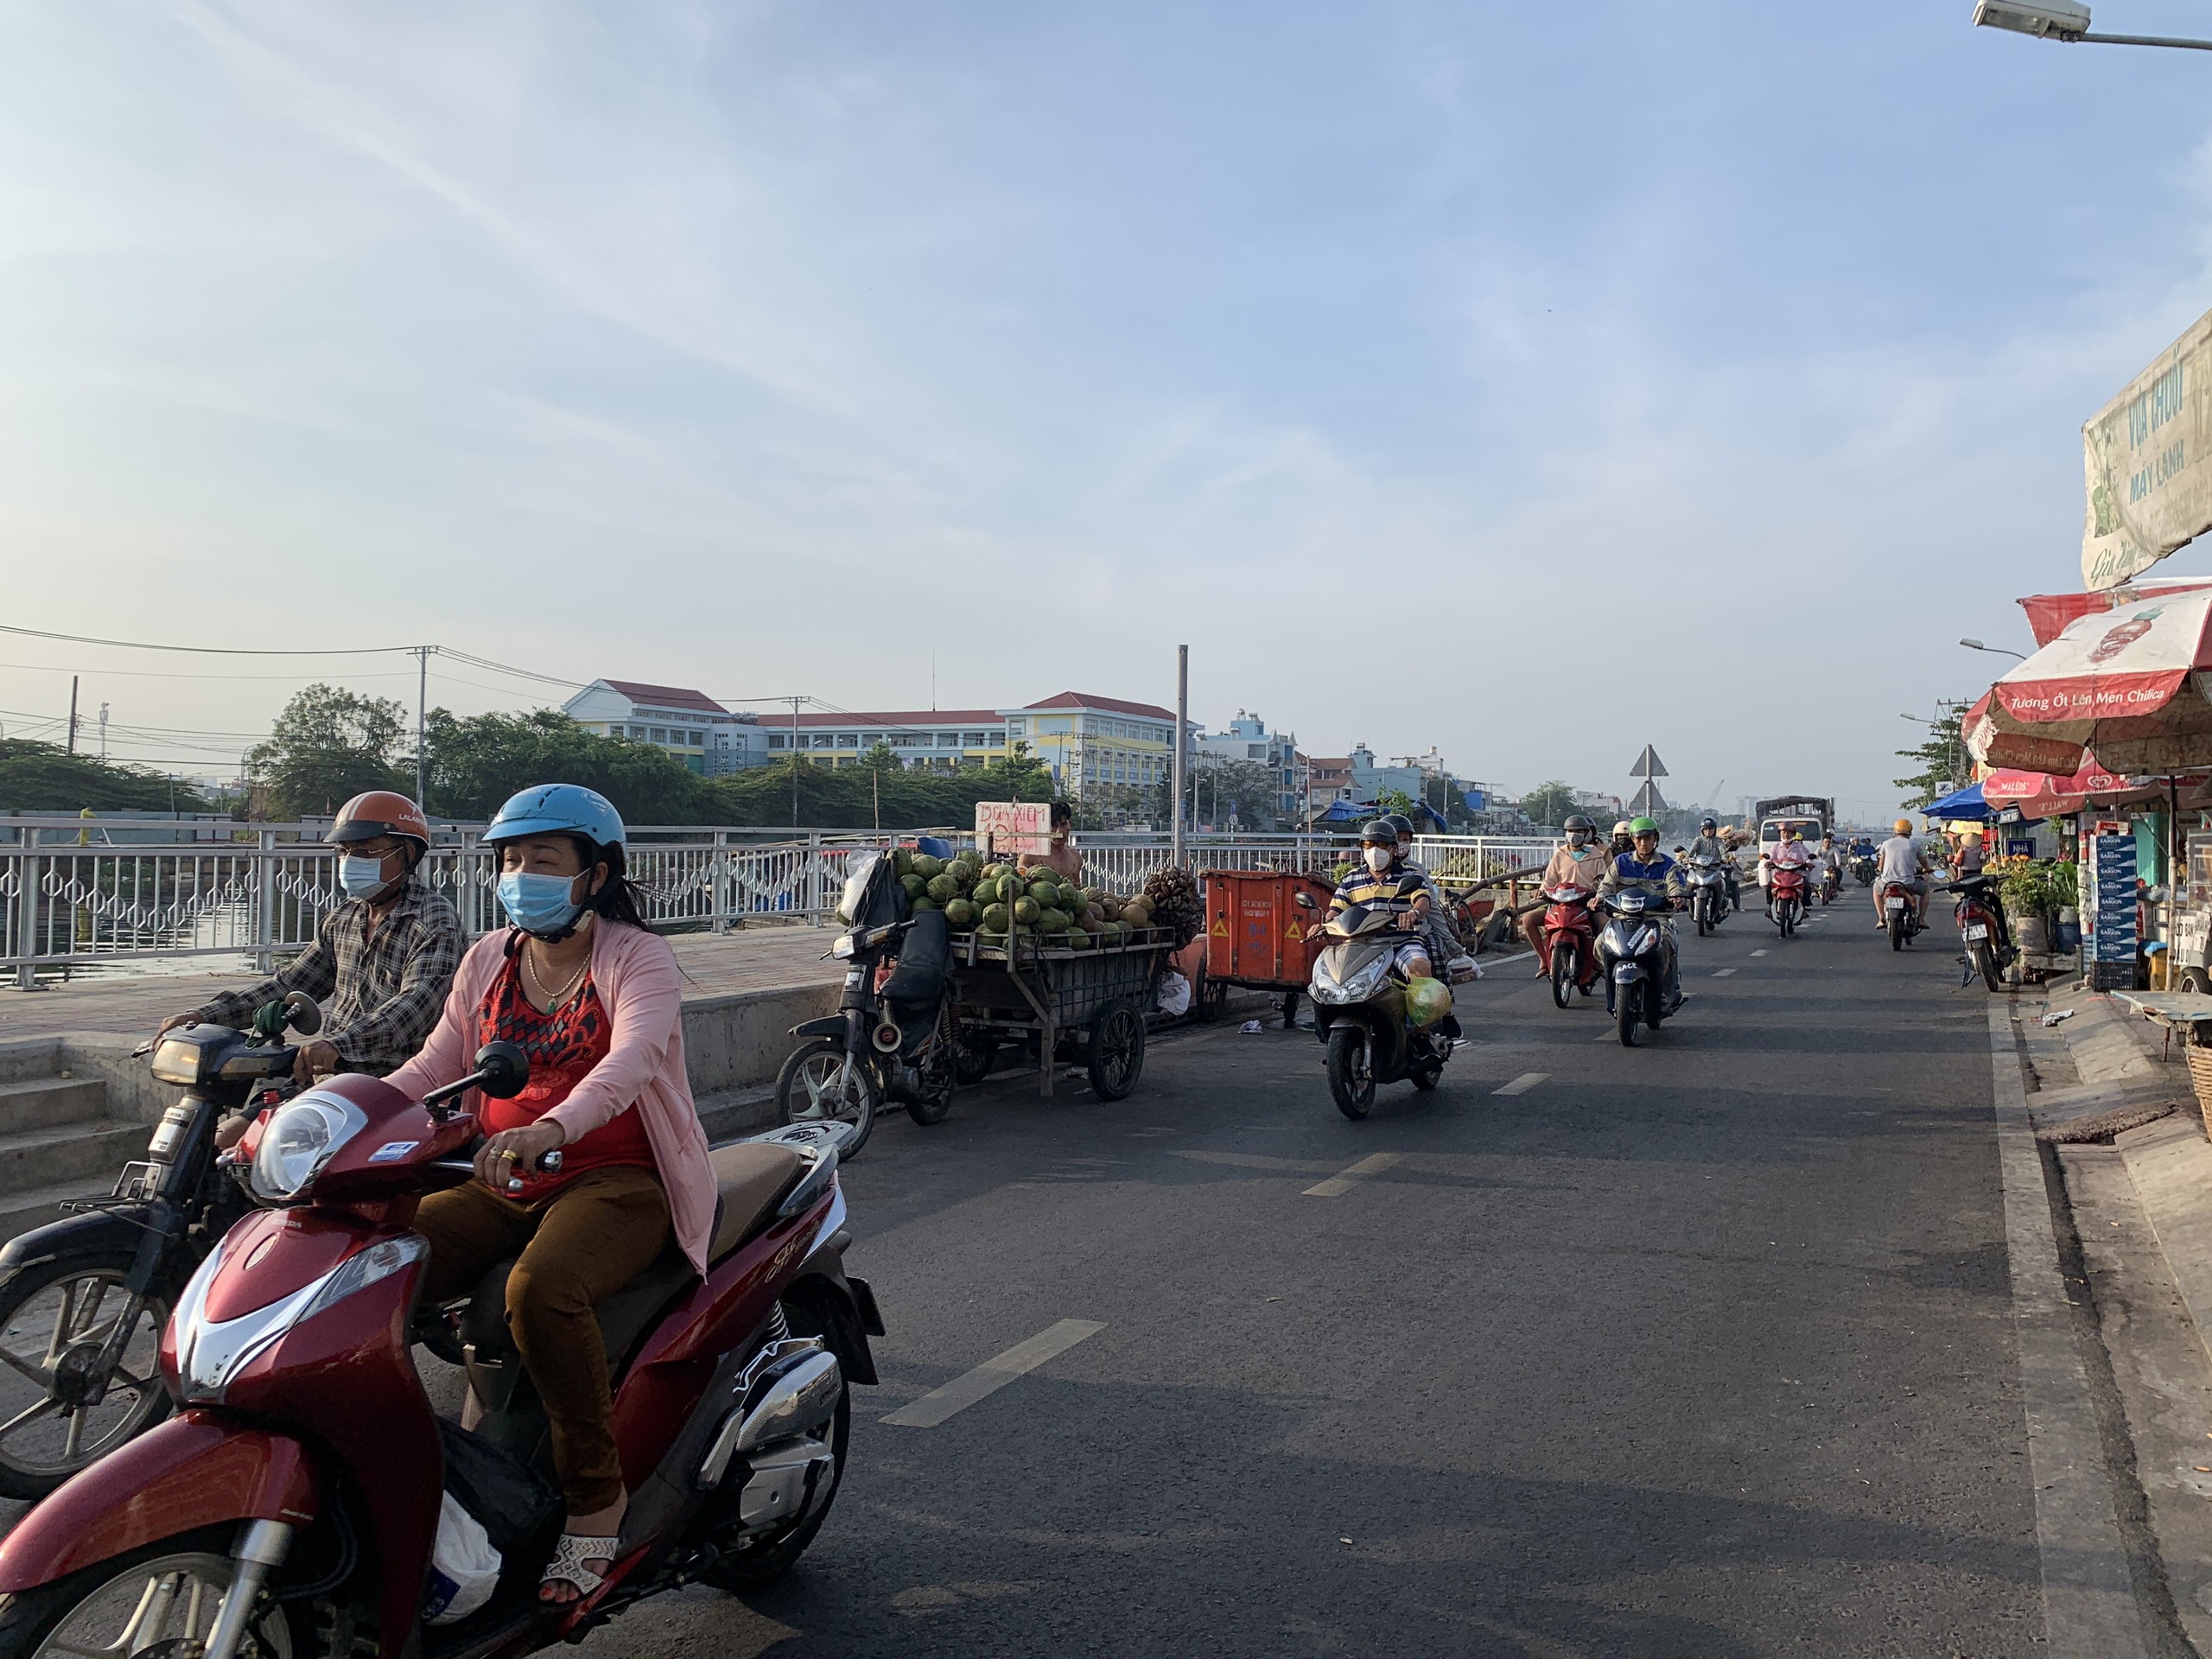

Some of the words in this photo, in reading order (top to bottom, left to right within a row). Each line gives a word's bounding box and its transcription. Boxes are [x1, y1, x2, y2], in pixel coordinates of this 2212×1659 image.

[2152, 342, 2183, 433] CHUỐI
[2130, 461, 2152, 505] MÁY
[2157, 439, 2184, 488] LẠNH
[2011, 697, 2050, 711] Tương
[2053, 691, 2068, 707] Ớt
[2072, 694, 2092, 706] Lên
[2096, 692, 2122, 704] Men
[2127, 690, 2164, 703] Chilica
